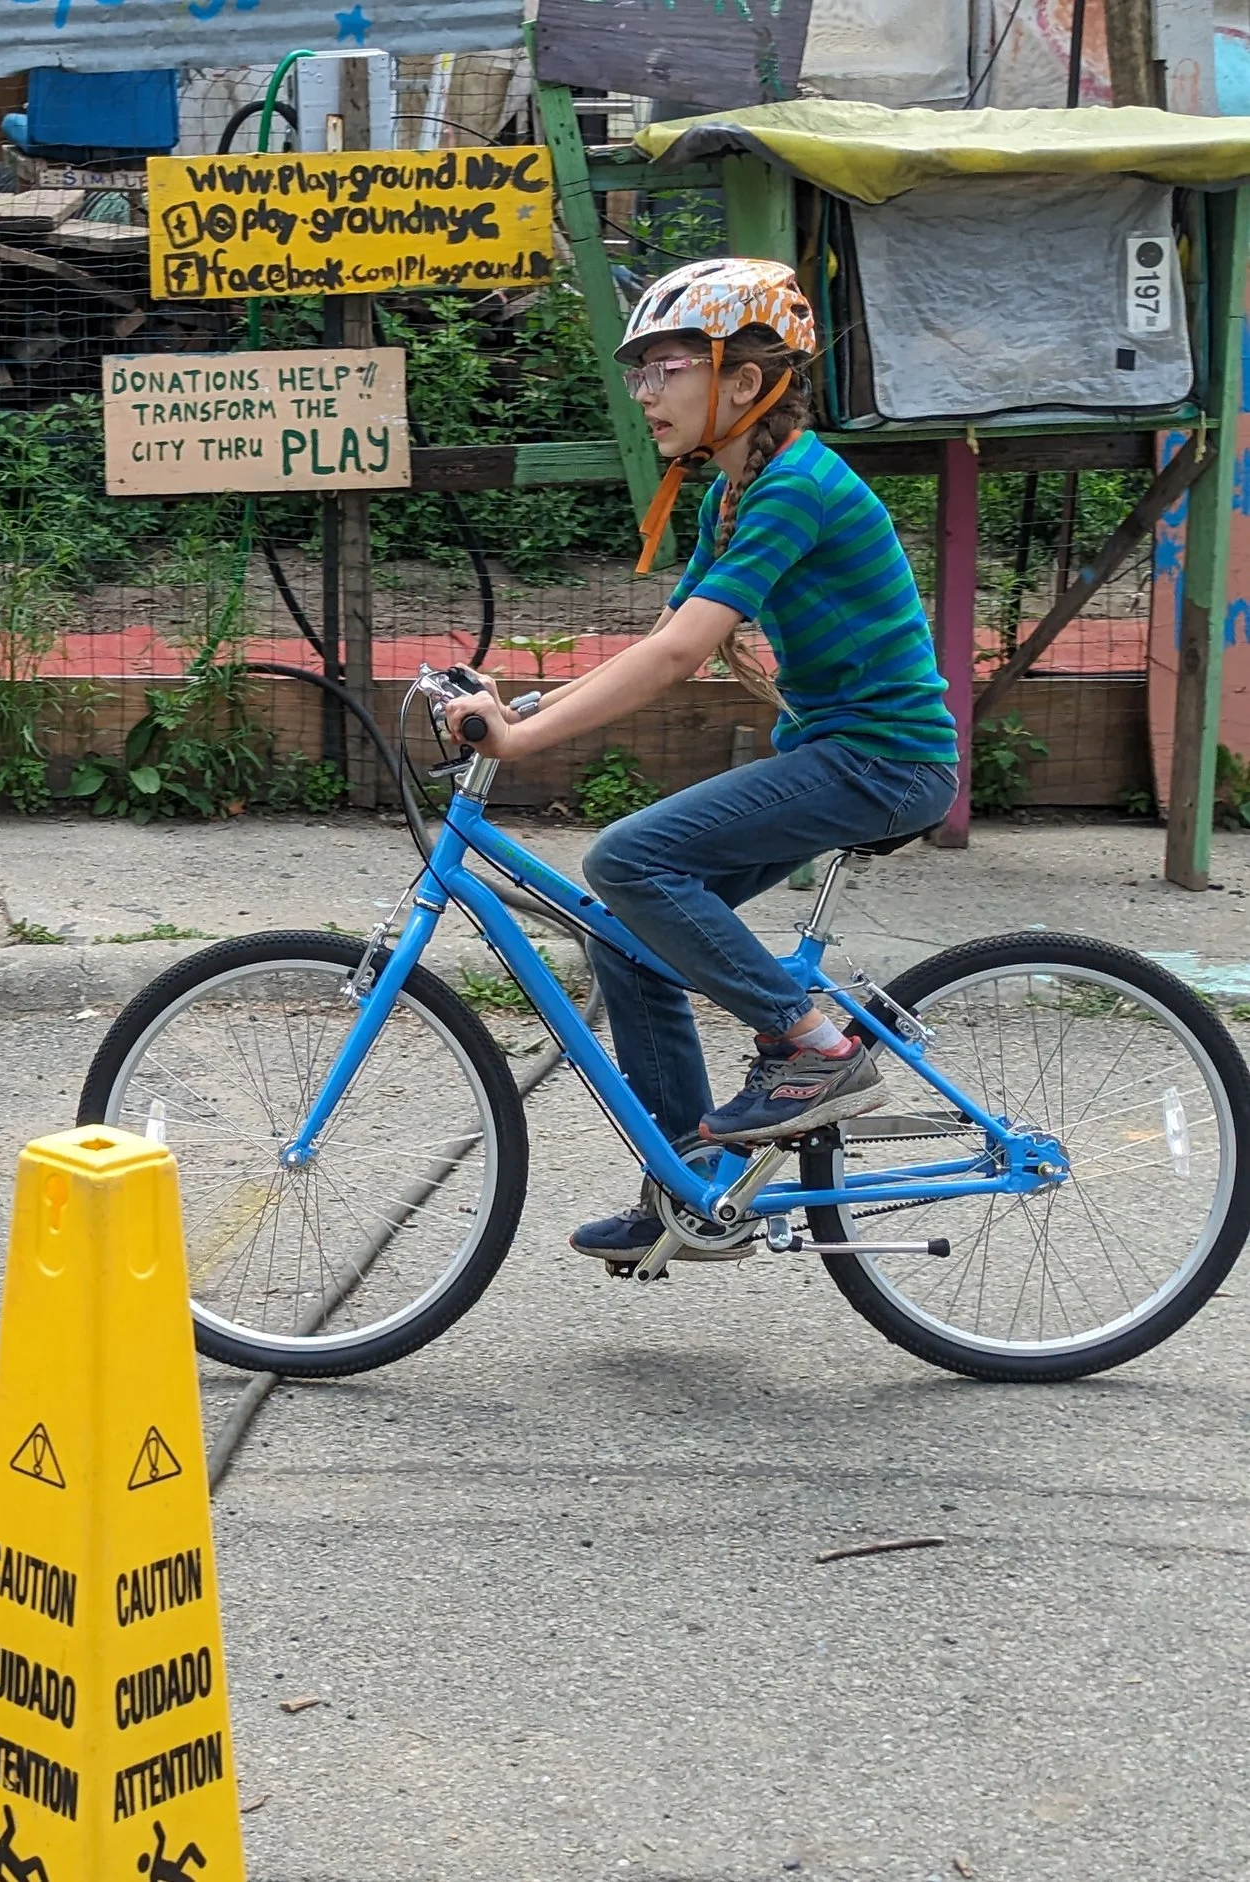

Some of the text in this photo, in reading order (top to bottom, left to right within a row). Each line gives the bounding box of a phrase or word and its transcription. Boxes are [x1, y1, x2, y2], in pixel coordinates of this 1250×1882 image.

[1134, 271, 1161, 314] 197
[112, 367, 260, 395] DONATIONS
[131, 397, 339, 426] TRANSFORM THE
[132, 439, 186, 463] CITY
[281, 426, 390, 476] PLAY
[115, 1547, 203, 1628] CAUTION
[115, 1646, 213, 1730] CUIDADO
[113, 1730, 224, 1824] ATTENTION
